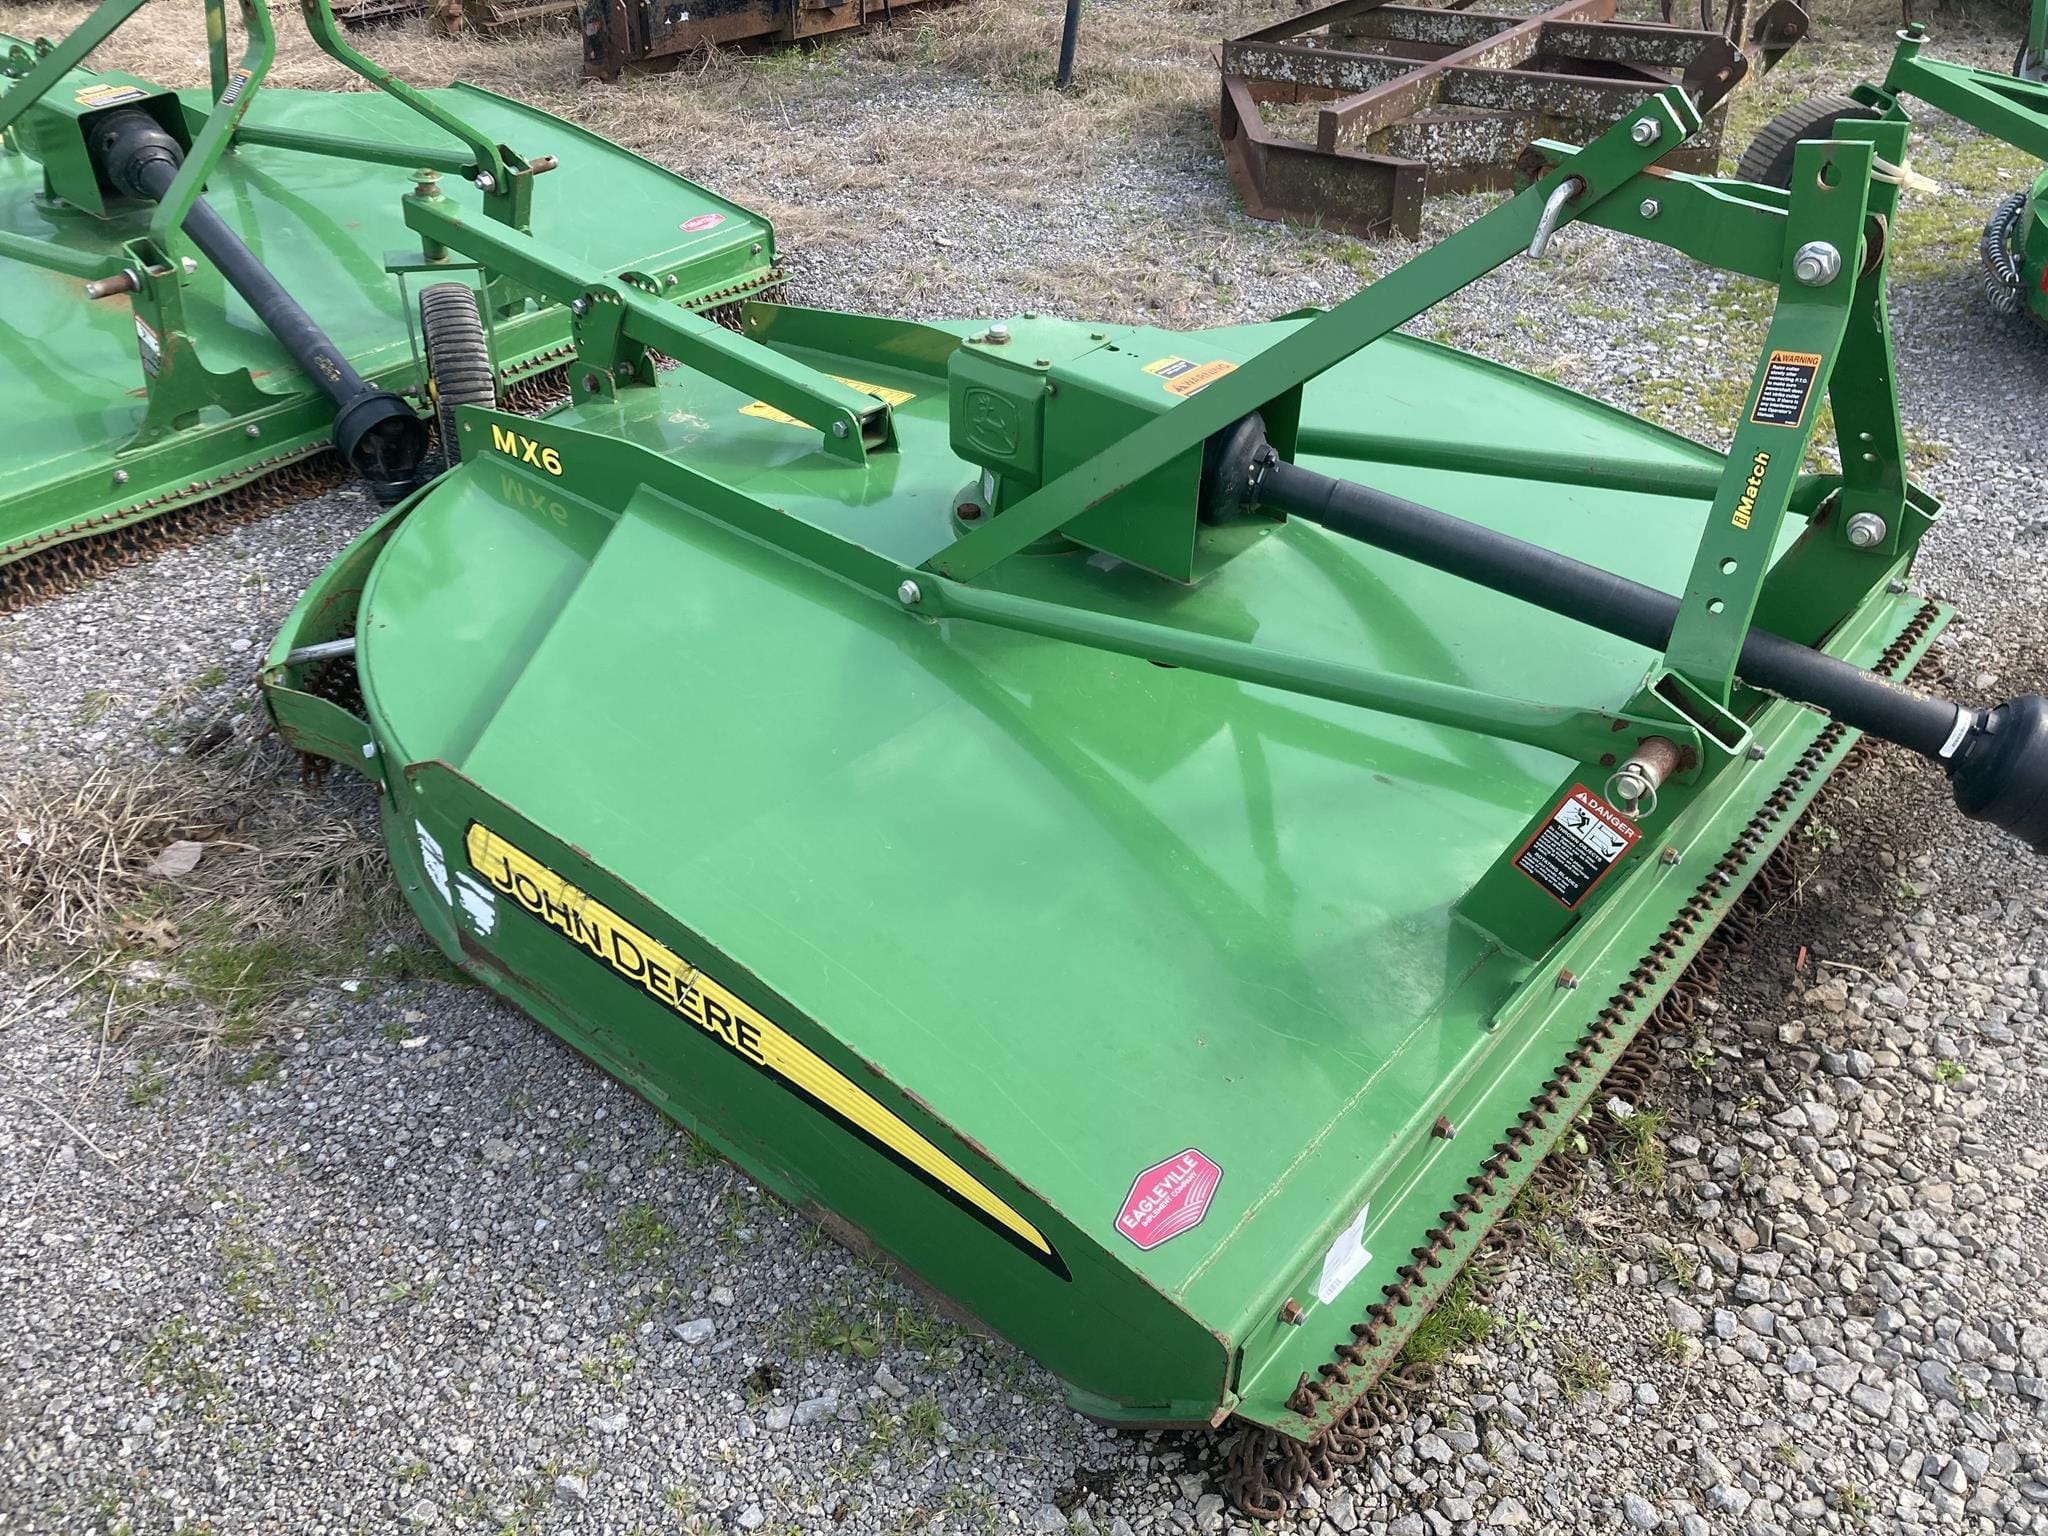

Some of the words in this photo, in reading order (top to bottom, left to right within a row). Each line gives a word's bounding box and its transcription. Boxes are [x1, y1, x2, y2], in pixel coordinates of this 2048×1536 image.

[1782, 354, 1819, 365] WARNING
[491, 423, 563, 476] MX6
[1732, 452, 1770, 529] iMatch
[1557, 825, 1580, 844] THROWN
[1578, 843, 1603, 862] OBJECTS
[1588, 799, 1635, 838] DANGER
[1534, 852, 1559, 873] ROTATING
[491, 857, 602, 954] JOHN
[611, 928, 763, 1062] DEERE
[1122, 1154, 1198, 1229] EAGLEVILLE
[1141, 1197, 1172, 1227] IMPLEMENT
[1170, 1171, 1197, 1197] COMPANY
